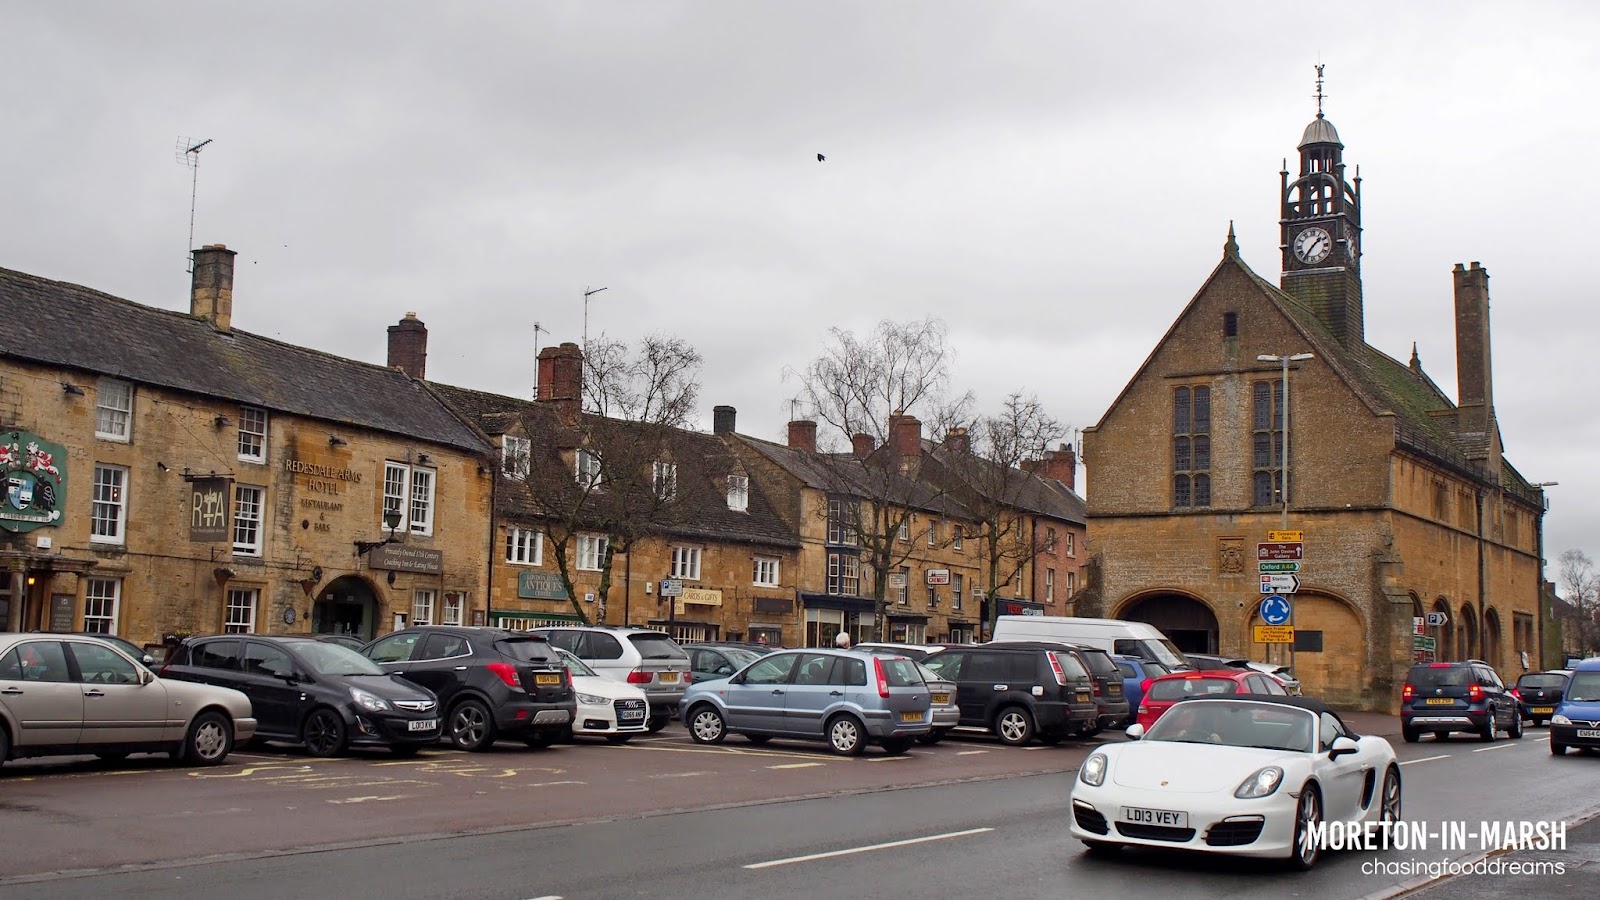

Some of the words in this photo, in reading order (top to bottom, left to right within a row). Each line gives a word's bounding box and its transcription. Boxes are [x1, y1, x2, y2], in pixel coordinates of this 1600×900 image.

[285, 459, 337, 479] REDESDALE
[337, 469, 362, 483] ARMS
[308, 479, 338, 495] HOTEL
[425, 552, 439, 562] Century
[525, 580, 563, 591] ANTIQUES
[684, 592, 701, 600] CARDS
[1430, 615, 1436, 623] P
[1127, 808, 1152, 823] LD13
[1155, 812, 1180, 825] VEY
